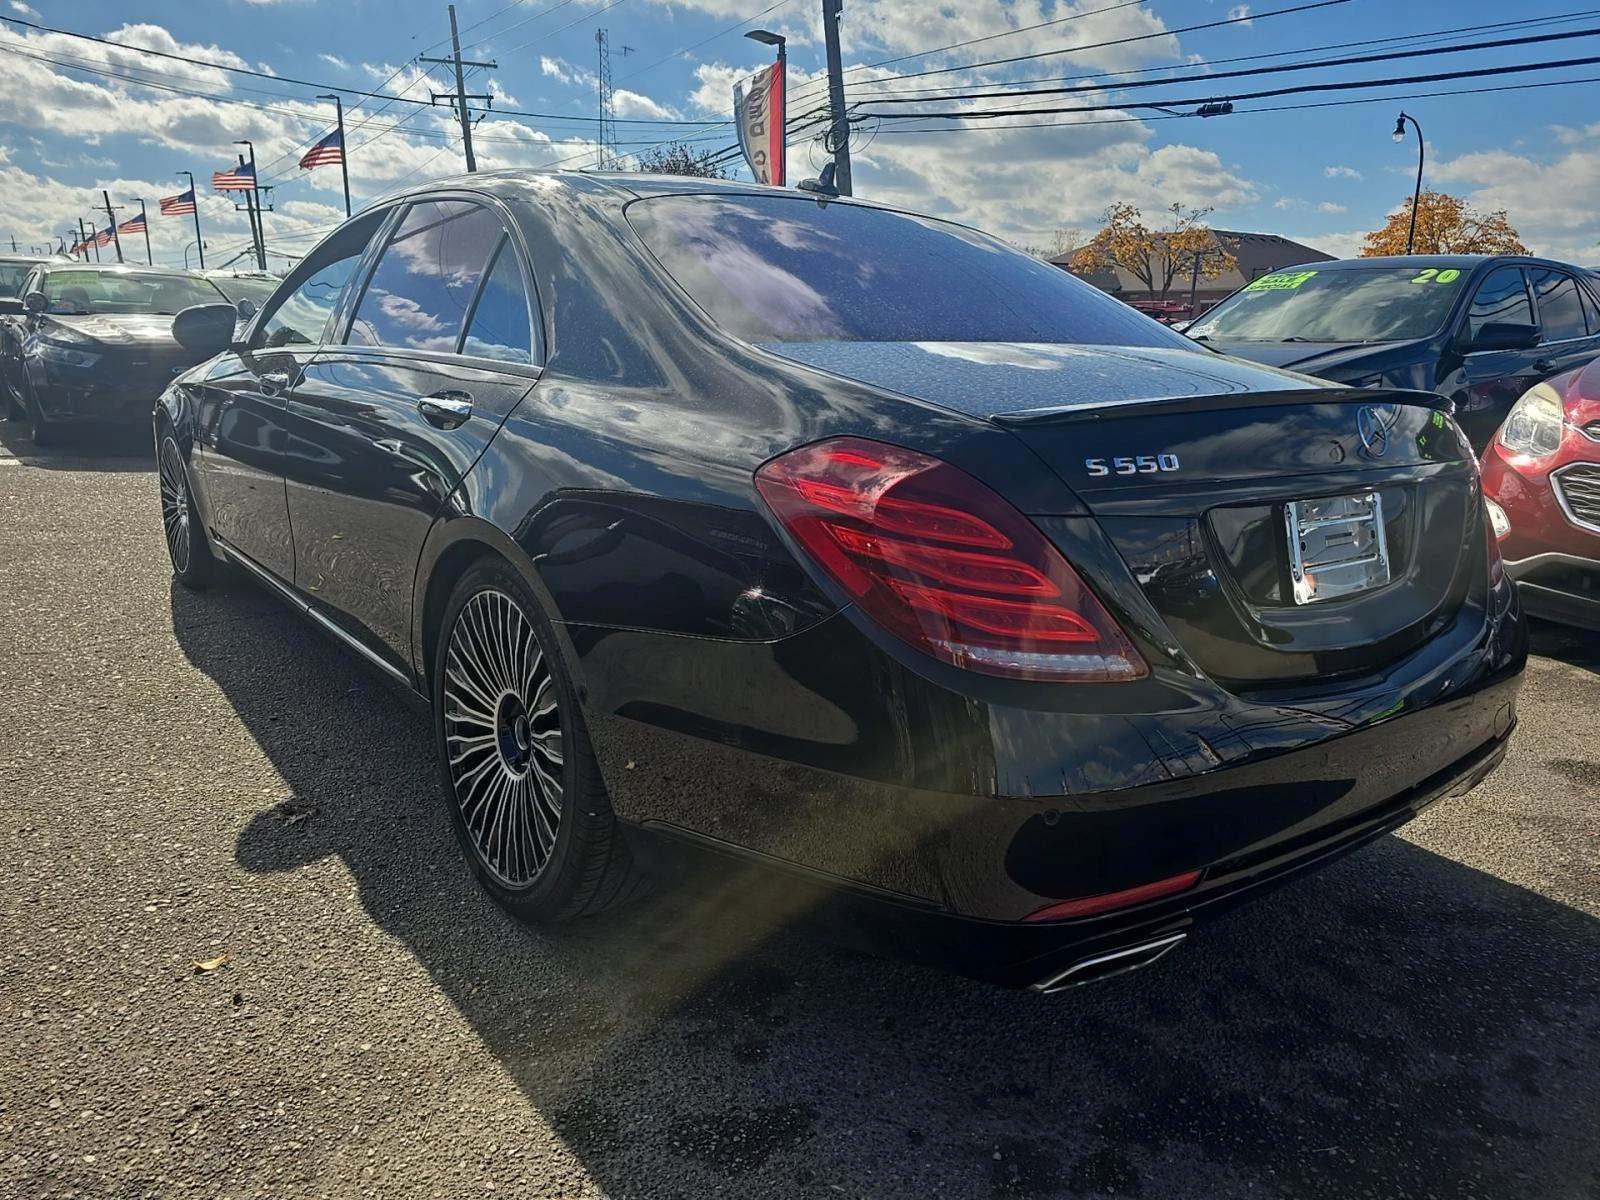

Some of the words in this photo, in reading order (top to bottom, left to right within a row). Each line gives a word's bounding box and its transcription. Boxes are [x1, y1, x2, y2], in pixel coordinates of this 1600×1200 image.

[1411, 268, 1460, 284] 20
[1085, 458, 1109, 476] S
[1113, 453, 1180, 475] 550
